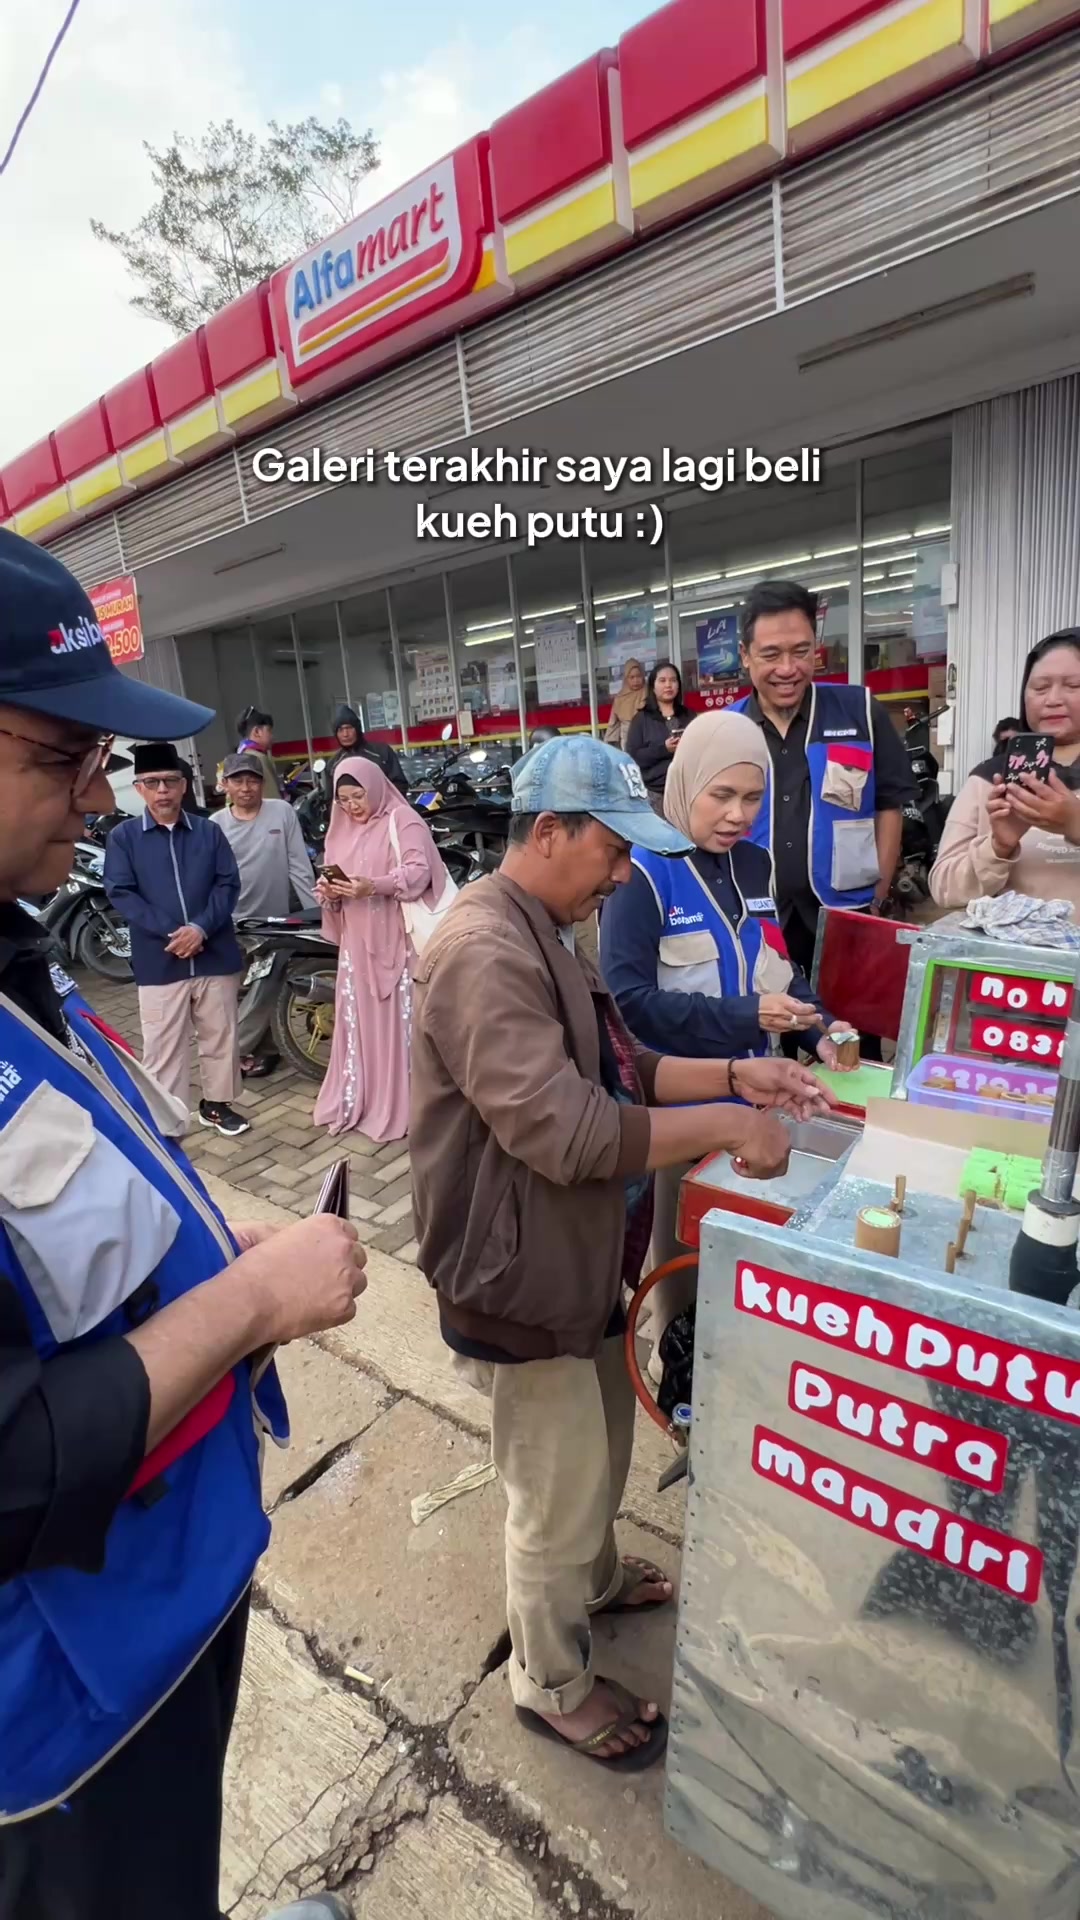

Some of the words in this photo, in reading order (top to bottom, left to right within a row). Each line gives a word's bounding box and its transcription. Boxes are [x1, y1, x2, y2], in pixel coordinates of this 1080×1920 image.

[293, 182, 444, 318] Alfamart
[104, 594, 134, 618] MURAH
[980, 976, 1028, 1008] no
[1041, 981, 1067, 1007] h
[741, 1268, 893, 1355] kueh
